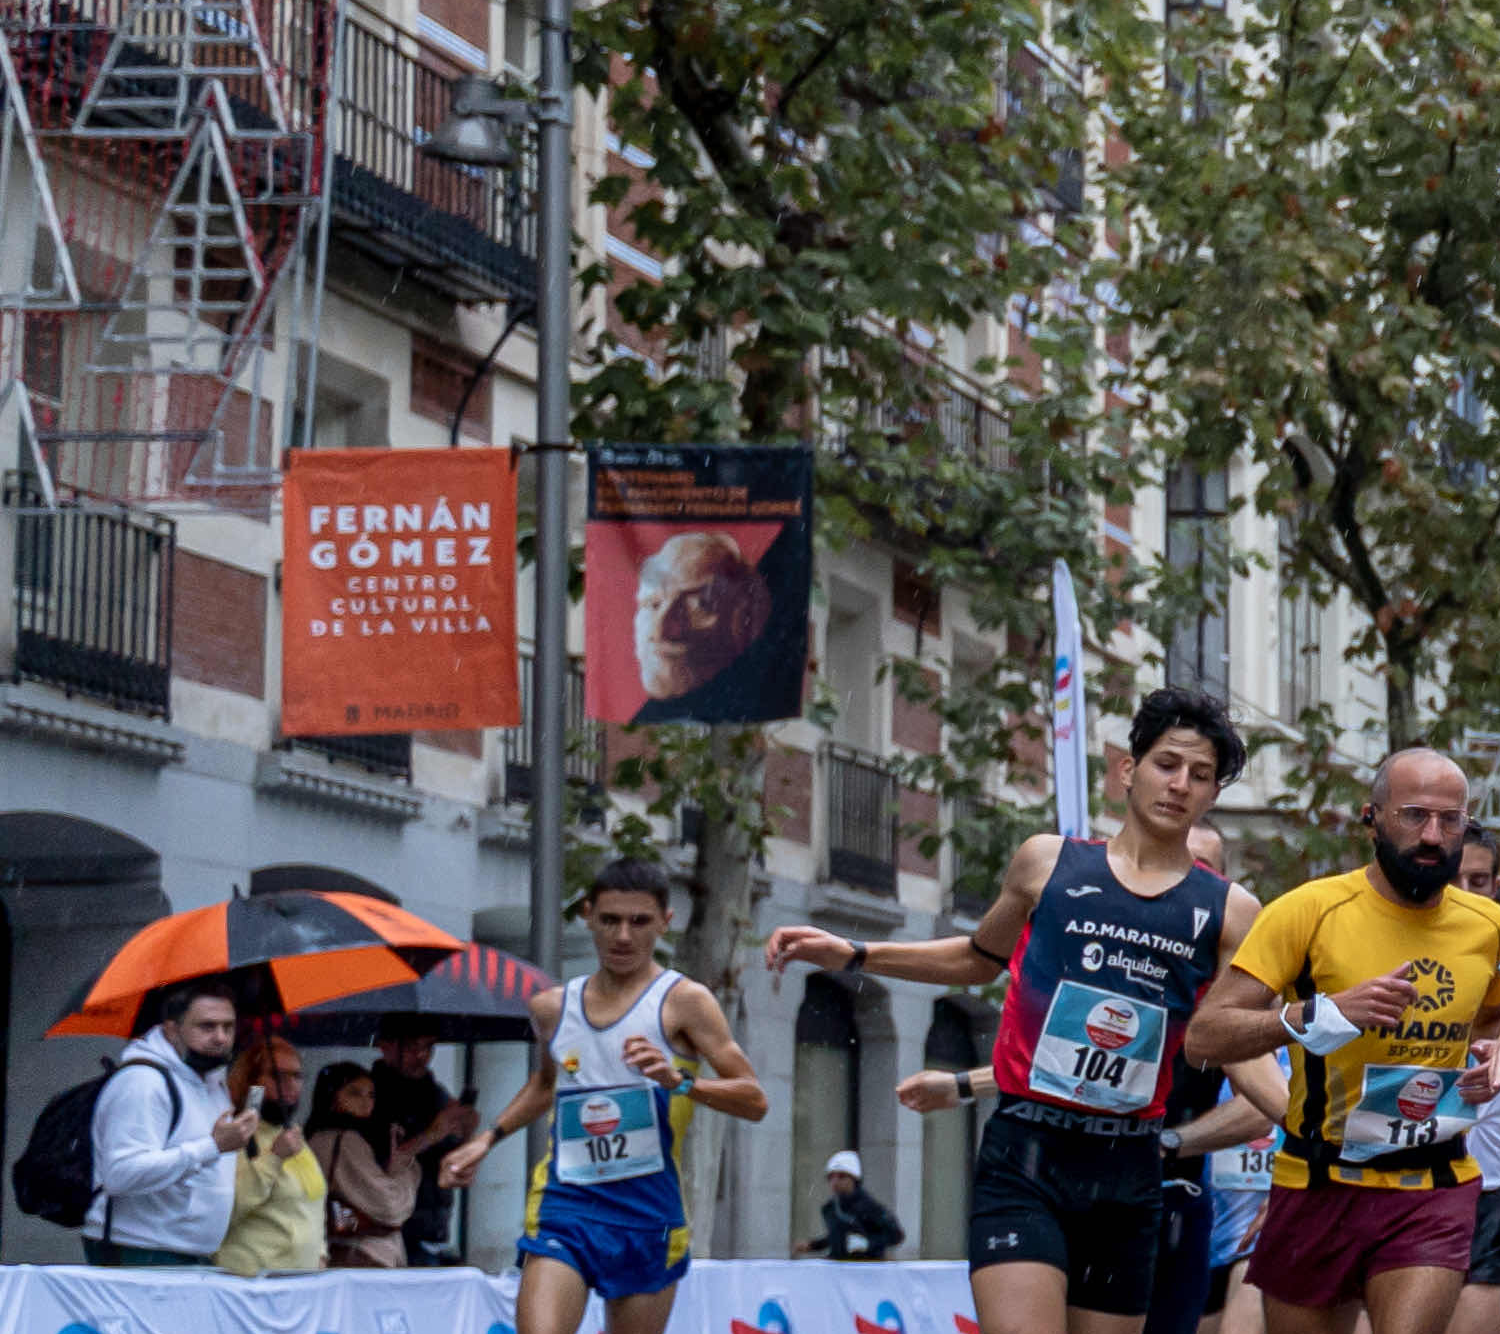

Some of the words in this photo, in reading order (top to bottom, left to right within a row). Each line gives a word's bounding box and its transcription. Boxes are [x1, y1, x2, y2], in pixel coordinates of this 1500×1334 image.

[309, 495, 491, 534] FERNÁN
[309, 533, 491, 569] GÓMEZ
[348, 574, 457, 593] CENTRO
[330, 595, 473, 615] CULTURAL
[310, 618, 344, 636] DE
[361, 618, 395, 636] LA
[411, 615, 491, 634] VILLA
[1065, 920, 1196, 960] A.D.MARATHON
[1107, 949, 1169, 984] alquiber
[1073, 1046, 1128, 1088] 104
[585, 1133, 629, 1164] 102
[1387, 1117, 1439, 1148] 113
